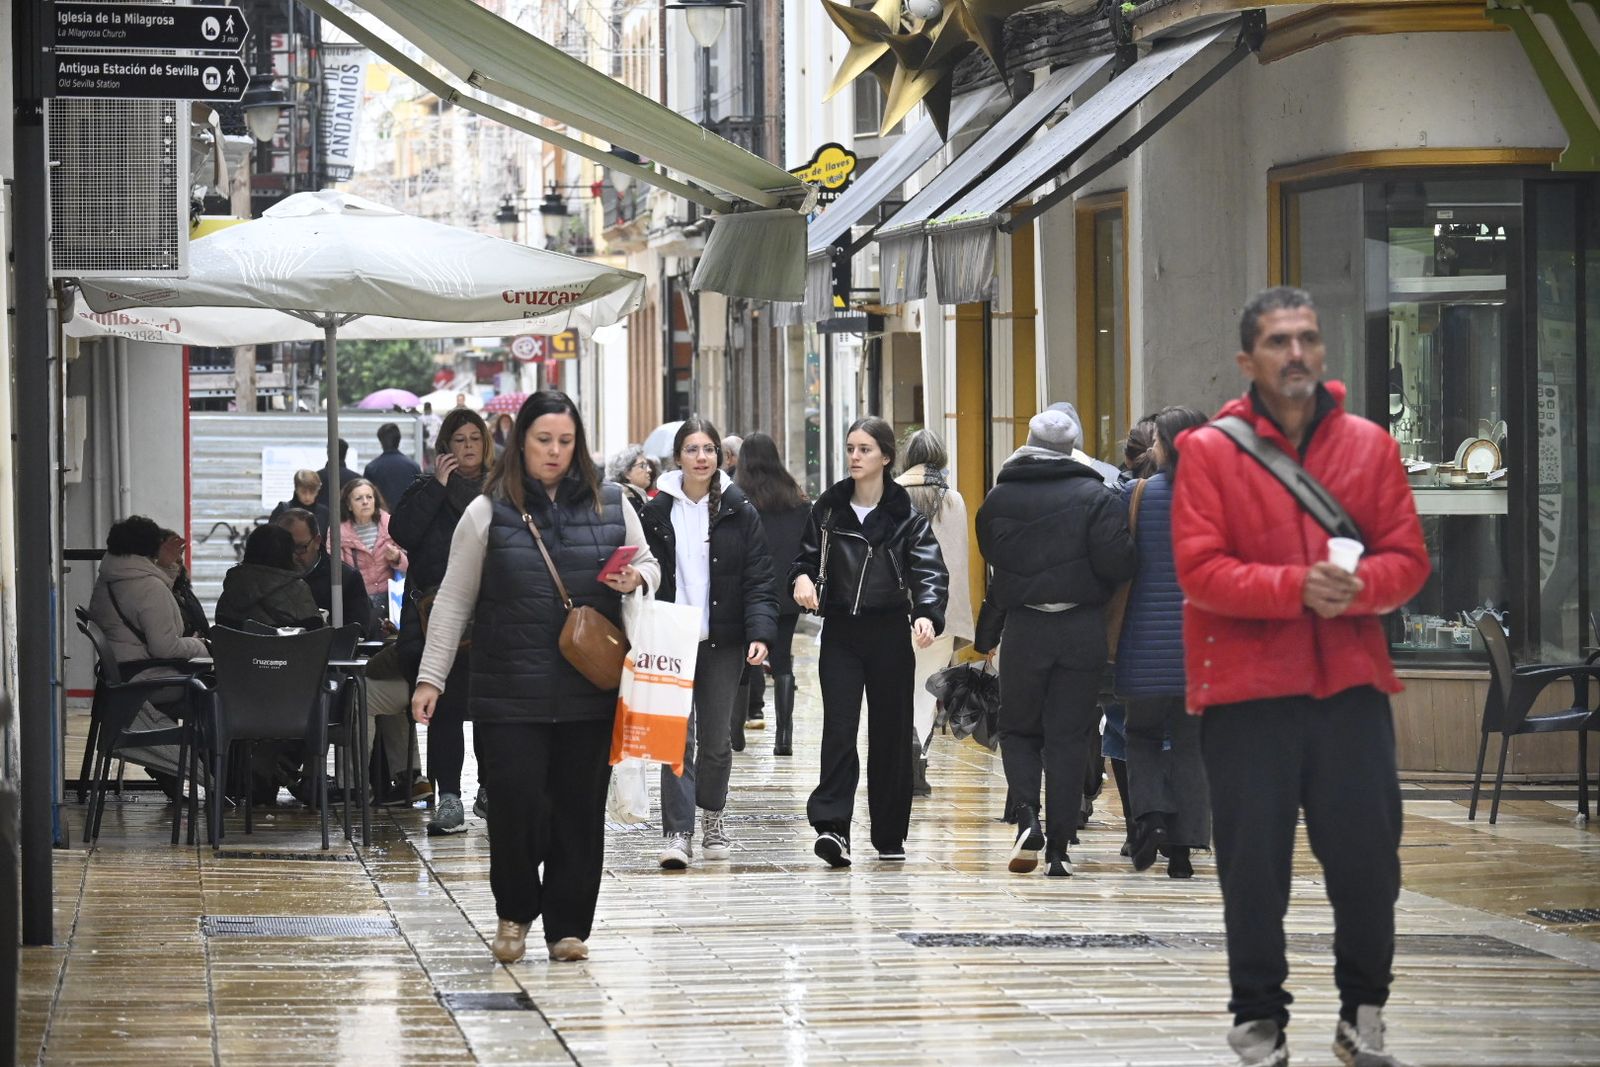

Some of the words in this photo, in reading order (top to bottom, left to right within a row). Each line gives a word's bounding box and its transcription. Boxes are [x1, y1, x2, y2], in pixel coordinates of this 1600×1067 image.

[57, 11, 92, 25] Iglesia
[95, 12, 109, 24] de
[111, 12, 121, 24] la
[124, 13, 175, 27] Milagrosa
[57, 28, 67, 37] La
[68, 28, 101, 39] Milagrosa
[102, 29, 126, 38] Church
[221, 35, 227, 43] 3
[227, 35, 239, 43] min
[58, 62, 100, 76] Antigua
[103, 62, 147, 75] Estación
[150, 64, 162, 76] de
[165, 64, 199, 77] Sevilla
[58, 79, 71, 88] Old
[72, 79, 95, 88] Sevilla
[96, 79, 120, 89] Station
[222, 85, 228, 93] 5
[228, 85, 240, 93] min
[331, 63, 361, 158] ANDAMIOS
[812, 167, 822, 176] de
[825, 159, 850, 172] llaves
